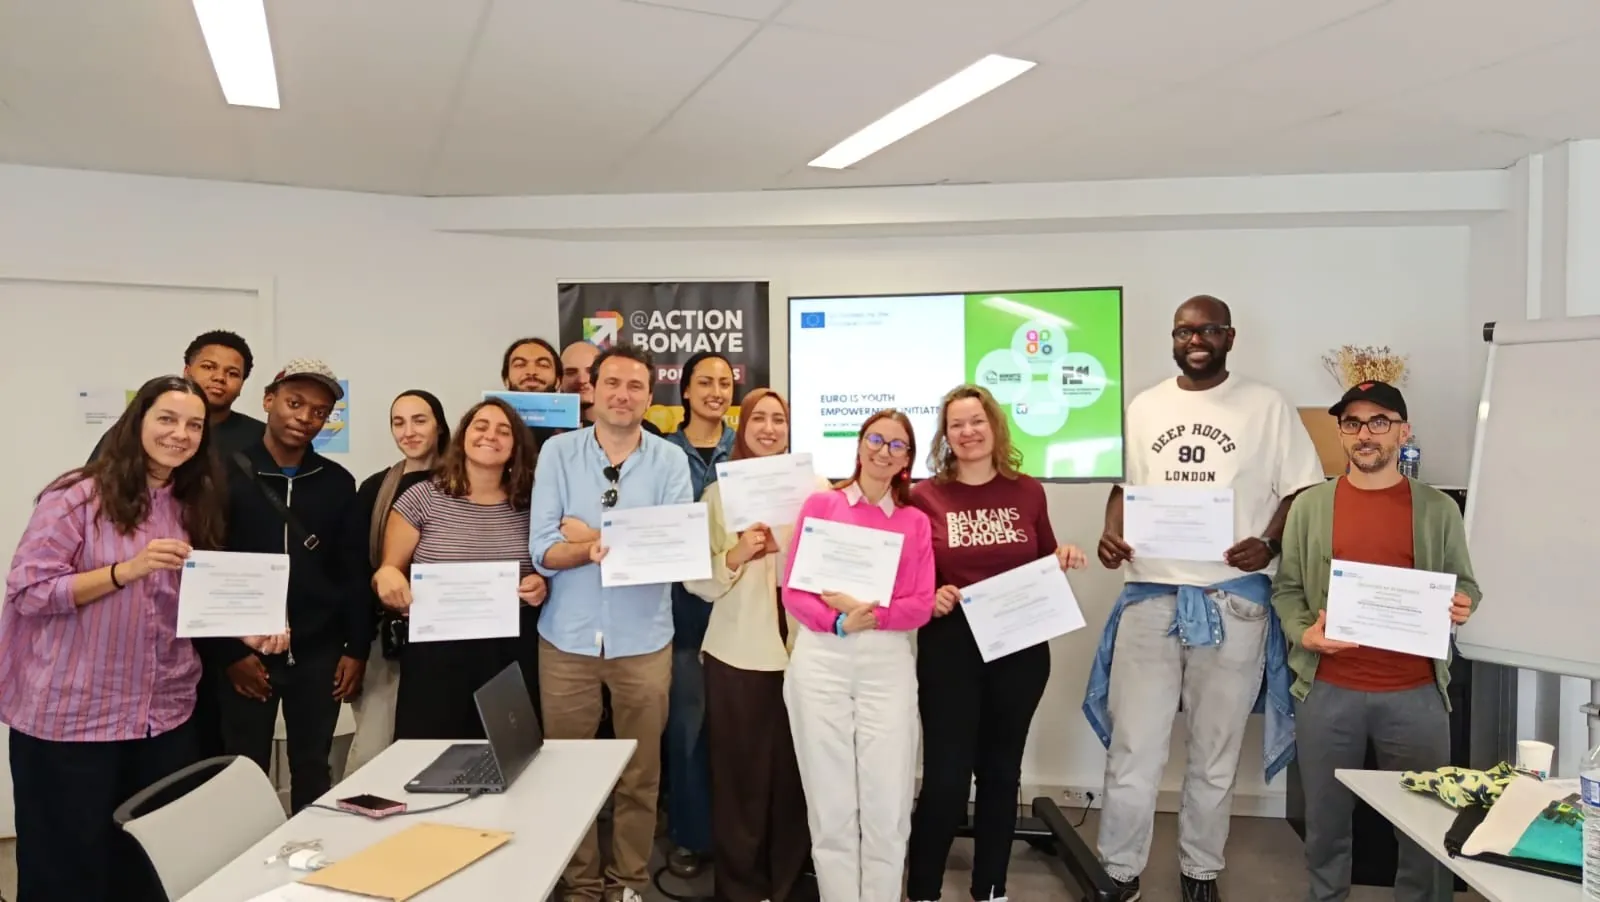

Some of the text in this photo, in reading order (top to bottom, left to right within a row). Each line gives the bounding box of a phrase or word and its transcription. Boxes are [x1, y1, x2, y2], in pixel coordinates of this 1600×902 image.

[629, 310, 743, 330] @ACTION
[632, 332, 744, 353] BOMAYE
[820, 393, 896, 403] EURO IS YOUTH
[1151, 423, 1236, 454] DEEP ROOTS
[1178, 445, 1206, 463] 90
[1165, 470, 1216, 482] LONDON
[946, 507, 1020, 524] BALKANS
[948, 519, 1013, 536] BEYOND
[948, 528, 1028, 548] BORDERS
